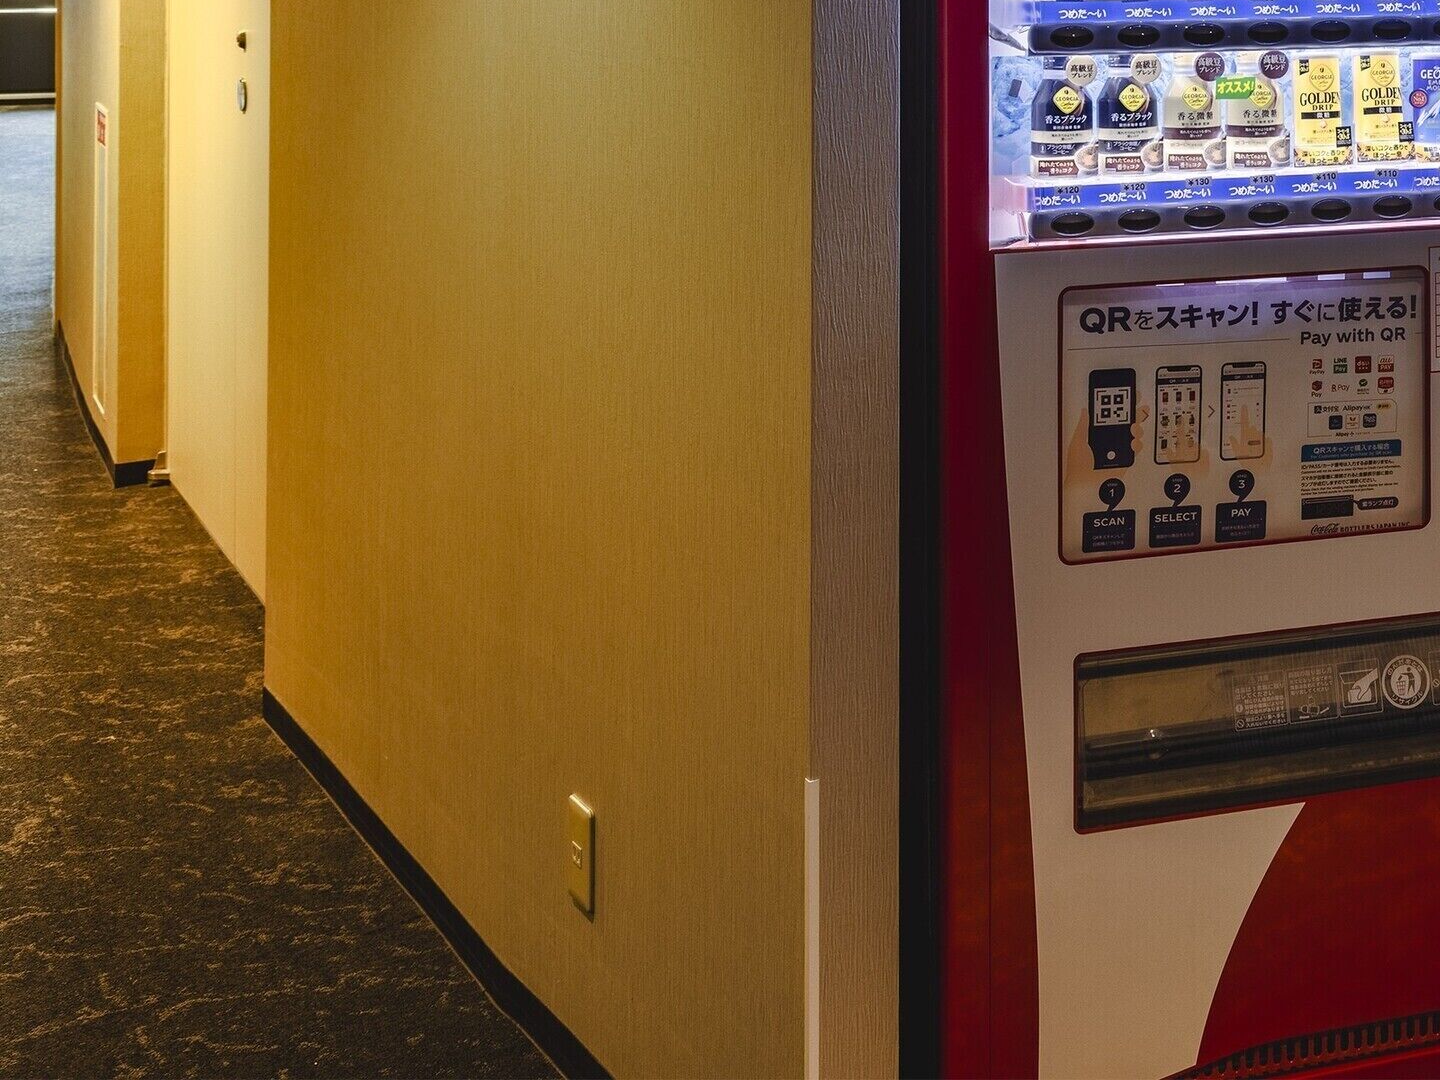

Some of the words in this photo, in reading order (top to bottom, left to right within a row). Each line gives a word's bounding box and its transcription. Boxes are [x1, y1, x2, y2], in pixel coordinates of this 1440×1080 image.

[1071, 64, 1093, 72] 高級豆
[1135, 60, 1157, 69] 高級豆
[1218, 82, 1254, 94] オススメ!
[1045, 115, 1087, 124] 香るブラック
[1178, 112, 1213, 120] 香る微糖
[1079, 301, 1258, 334] QRをスキャン!
[1271, 294, 1416, 325] すぐに使える!
[1300, 330, 1330, 346] Pay
[1336, 328, 1375, 343] with
[1380, 327, 1405, 342] QR
[1238, 479, 1245, 488] 3
[1109, 489, 1114, 497] 1
[1174, 484, 1180, 493] 2
[1154, 512, 1198, 523] SELECT
[1231, 508, 1251, 518] PAY
[1093, 517, 1125, 527] SCAN
[1311, 523, 1340, 535] Coca-Cola
[1340, 524, 1374, 532] BOTTLERS
